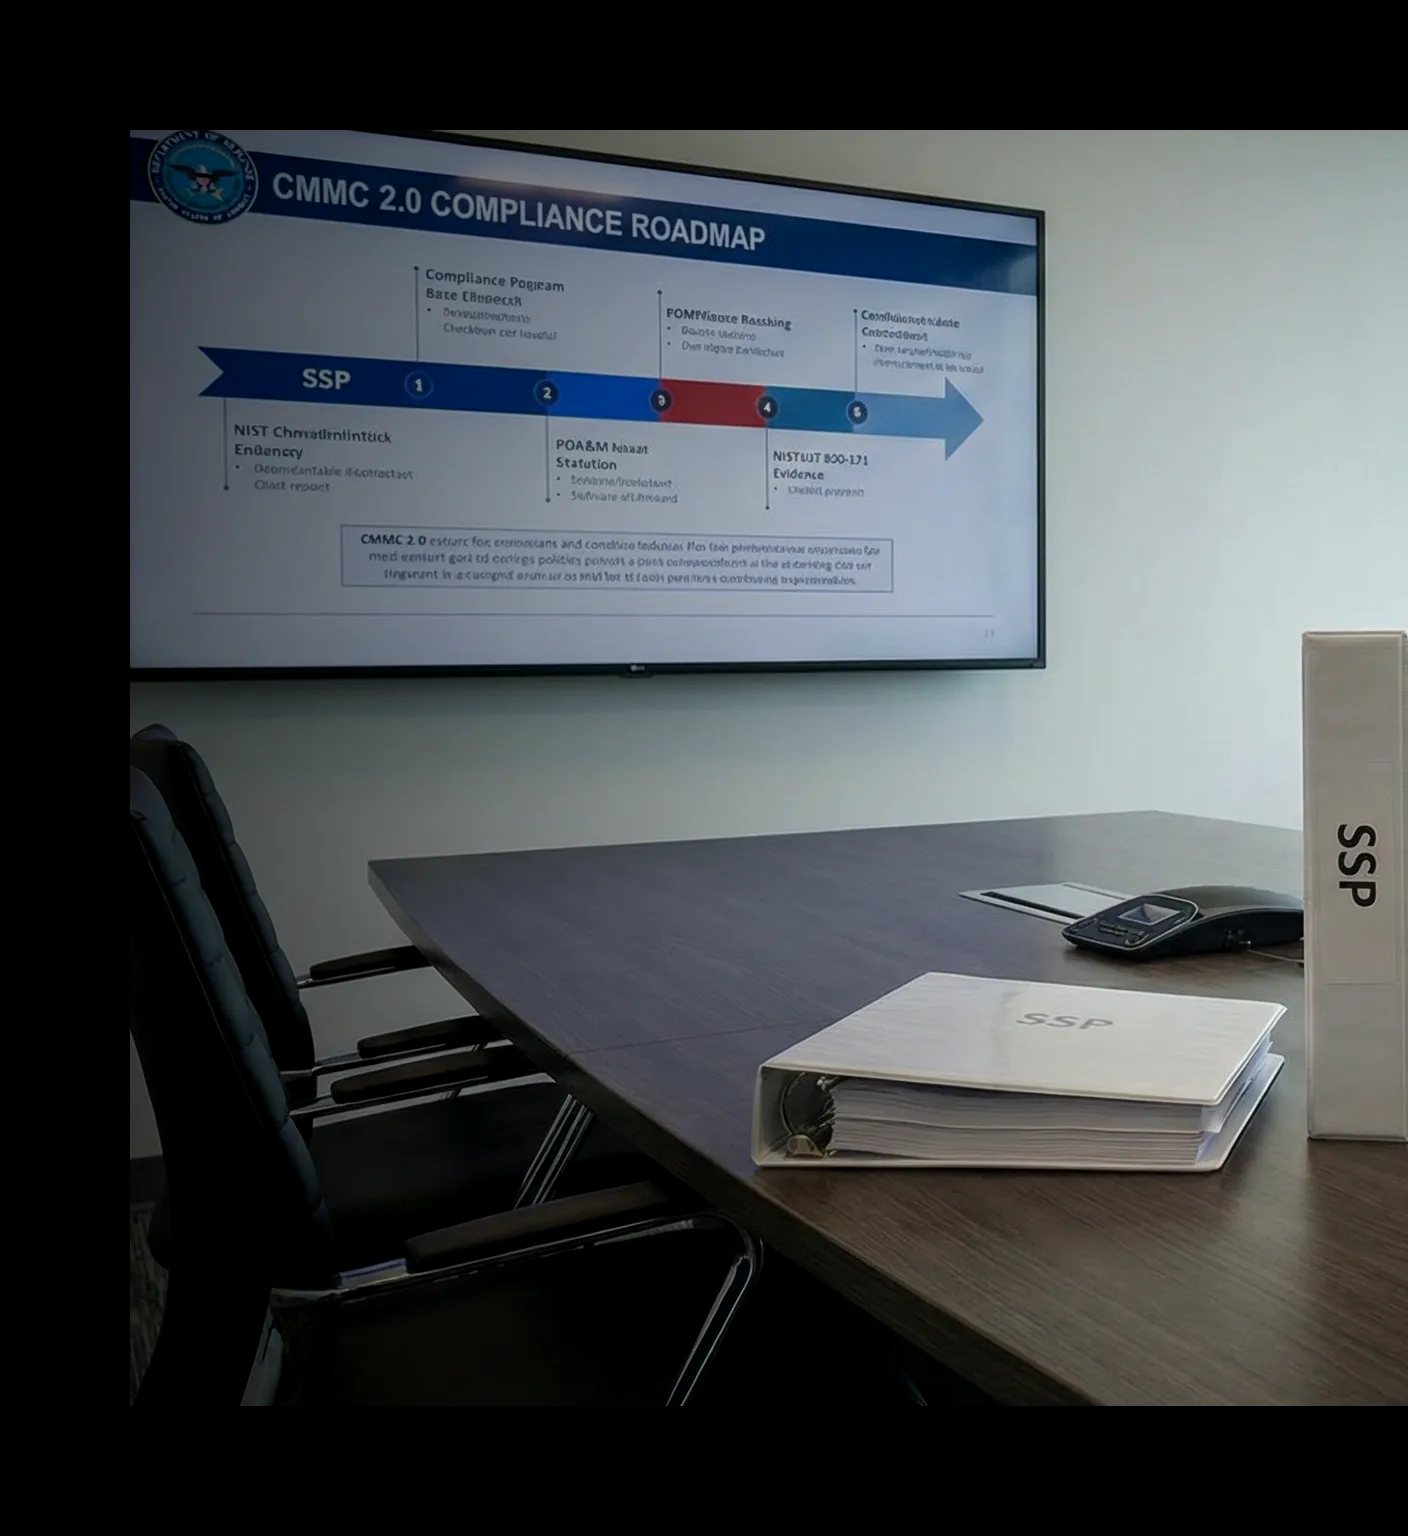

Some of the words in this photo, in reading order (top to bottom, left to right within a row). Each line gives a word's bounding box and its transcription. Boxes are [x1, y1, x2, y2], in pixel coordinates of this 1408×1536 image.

[272, 172, 369, 208] CMMC
[380, 185, 421, 214] 2.0
[431, 190, 622, 236] COMPLIANCE
[631, 212, 765, 251] ROADMAP
[302, 368, 351, 391] SSP
[414, 378, 424, 392] 1
[543, 387, 552, 399] 2
[763, 402, 772, 414] 4
[234, 424, 269, 437] NIST
[556, 439, 608, 453] POA&M
[360, 534, 404, 545] CMMC
[1337, 824, 1377, 907] SSP
[1016, 1012, 1113, 1029] SSP
